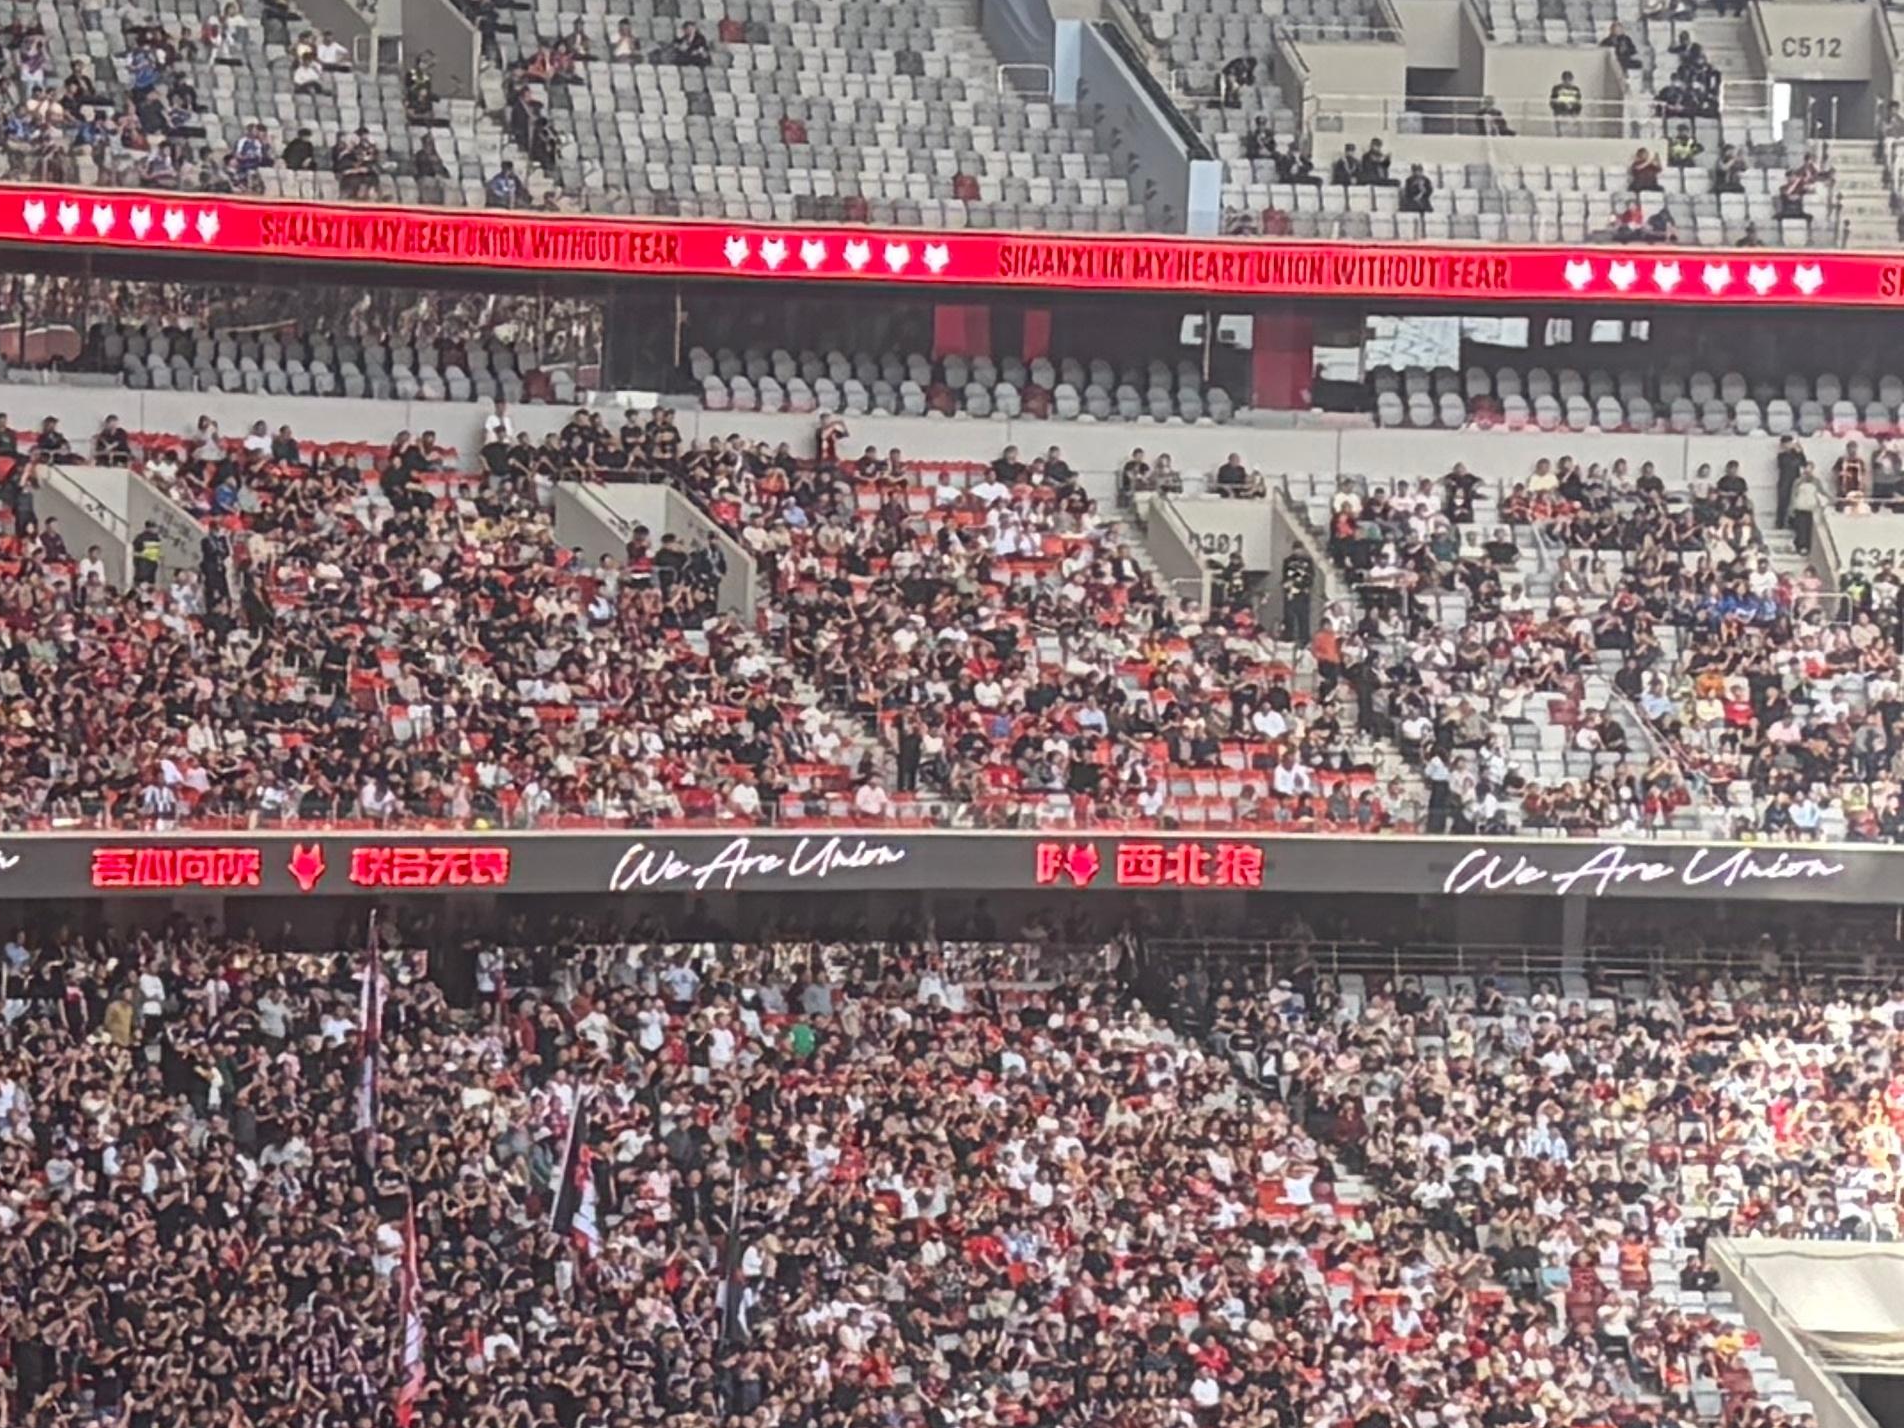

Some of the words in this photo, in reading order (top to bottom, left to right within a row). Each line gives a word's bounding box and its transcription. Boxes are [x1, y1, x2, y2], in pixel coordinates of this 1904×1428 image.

[259, 212, 341, 249] SHAANXI
[370, 219, 403, 253] MY
[404, 221, 460, 256] HEART
[465, 223, 525, 259] UNION
[530, 225, 624, 262] WITHOUT
[628, 231, 680, 264] FEAR
[999, 244, 1092, 279] SHAANXI
[1101, 246, 1124, 280] IN
[1132, 246, 1170, 282] MY
[1176, 248, 1252, 284] HEART
[1257, 251, 1325, 286] UNION
[1332, 253, 1443, 288] WITHOUT
[1448, 255, 1508, 290] FEAR
[348, 846, 510, 886] 联合无畏
[607, 844, 693, 892] We
[694, 836, 786, 891] Are
[789, 836, 907, 877] Union
[1443, 847, 1549, 895] We
[1556, 845, 1677, 896] Are
[1681, 847, 1845, 888] Union
